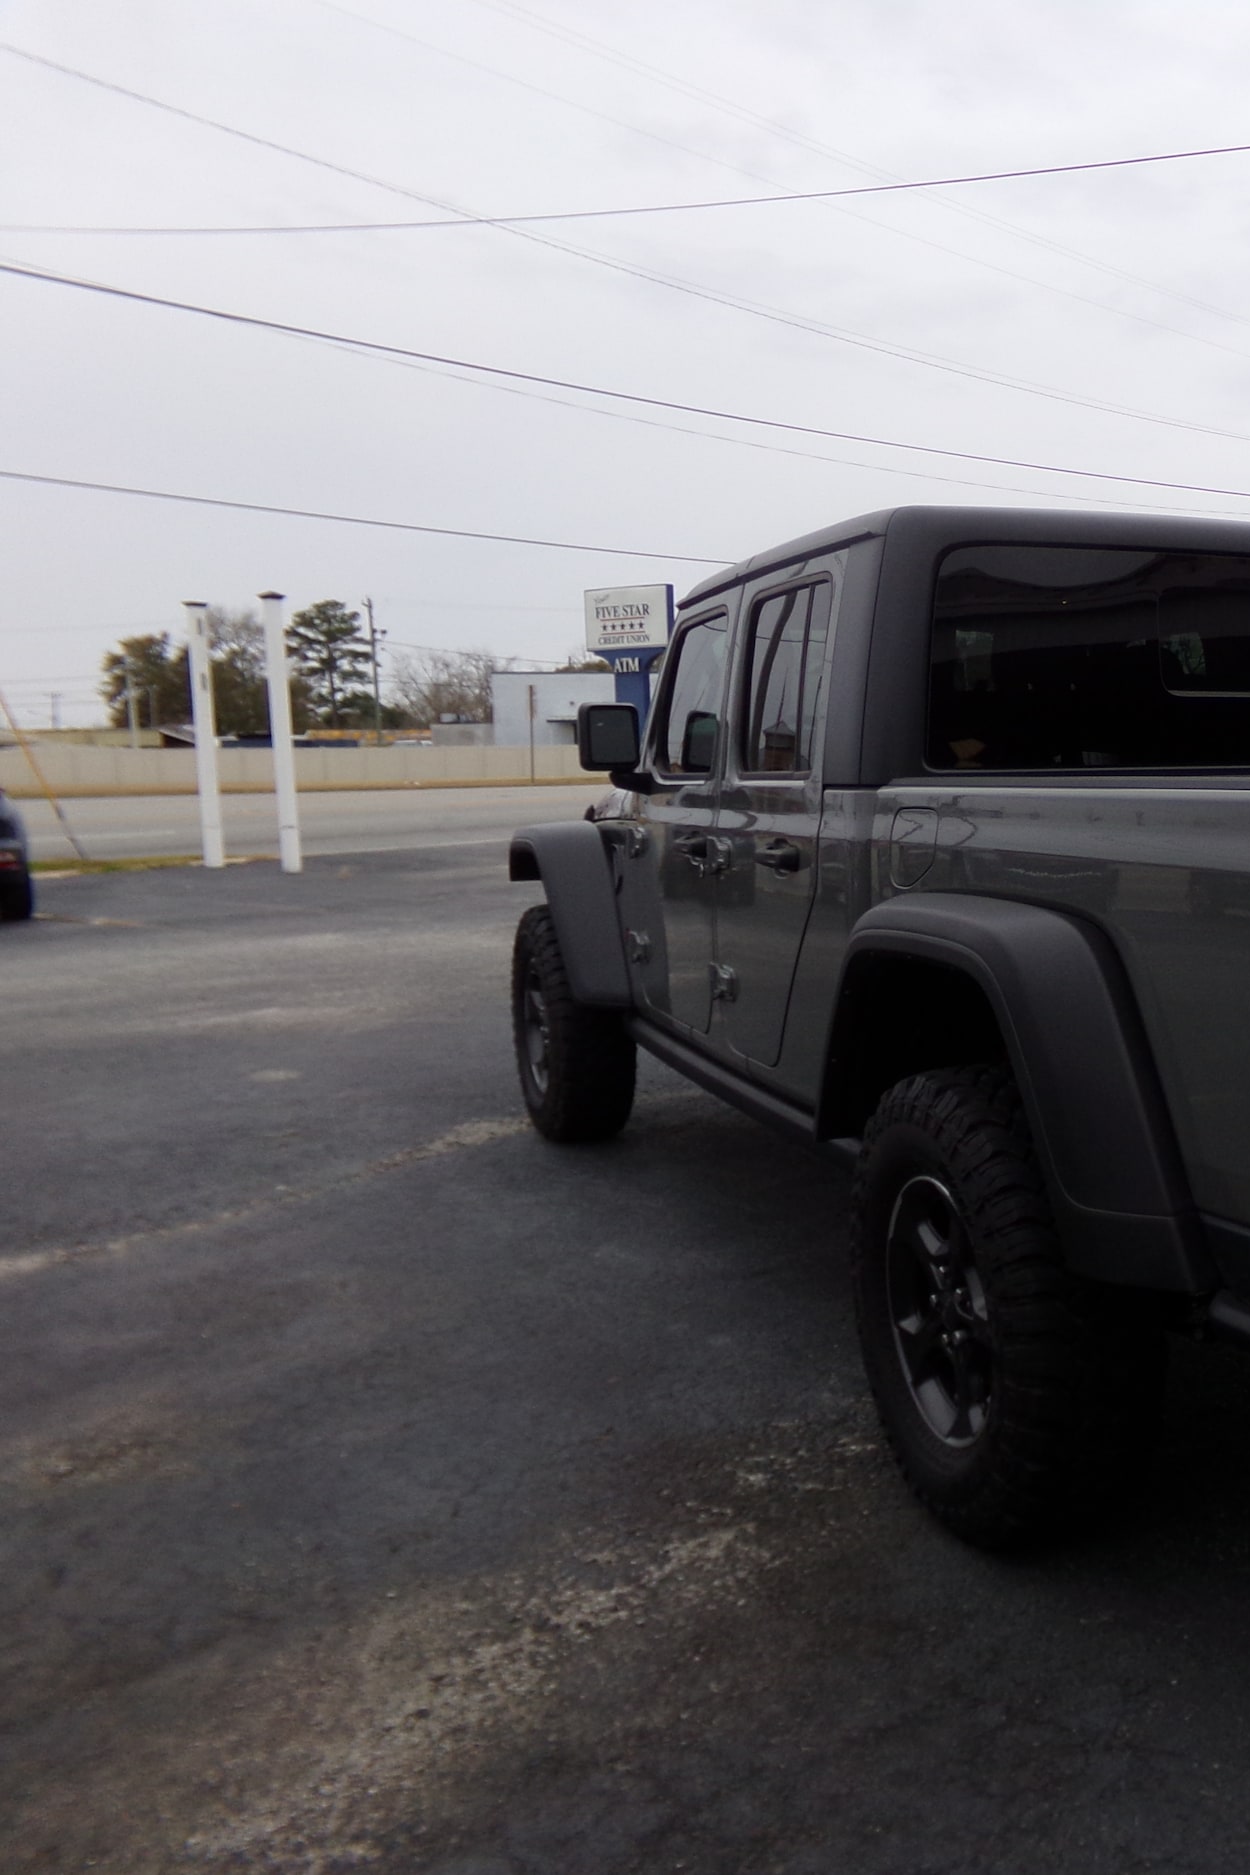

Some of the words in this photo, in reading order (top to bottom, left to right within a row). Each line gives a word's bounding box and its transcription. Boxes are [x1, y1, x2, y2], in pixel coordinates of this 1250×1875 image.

[595, 605, 620, 619] FIVE
[622, 603, 650, 617] STAR
[598, 635, 626, 645] CREDIT
[626, 634, 650, 643] UNION
[614, 657, 640, 673] ATM
